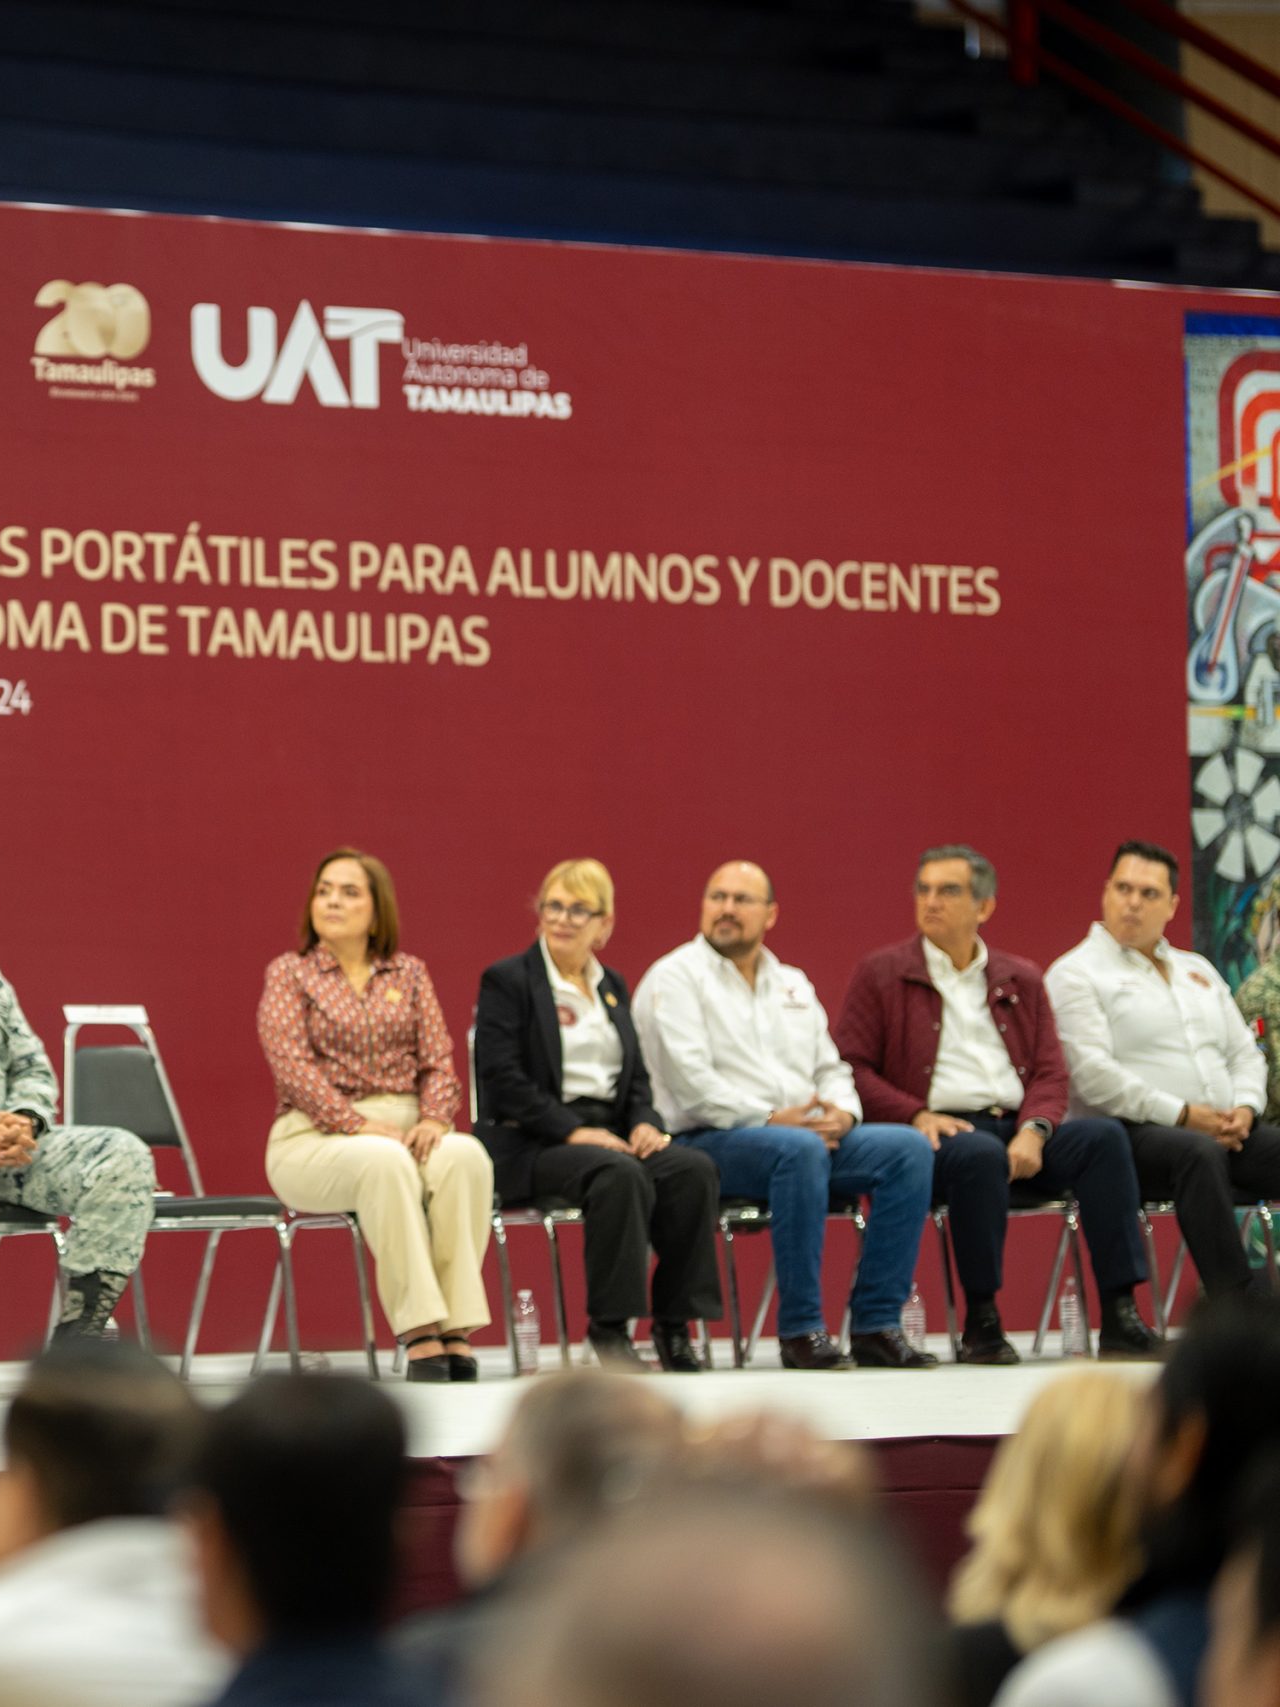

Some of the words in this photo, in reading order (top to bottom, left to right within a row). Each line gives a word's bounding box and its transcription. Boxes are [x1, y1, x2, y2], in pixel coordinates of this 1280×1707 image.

[191, 299, 405, 409] UAT
[401, 337, 528, 368] Universidad
[30, 356, 156, 390] Tamaulipas
[519, 364, 550, 391] de
[402, 383, 573, 420] TAMAULIPAS
[40, 521, 339, 590] PORTÁTILES
[348, 541, 478, 596] PARA
[485, 547, 720, 605] ALUMNOS
[727, 556, 760, 607] Y
[768, 557, 1002, 616] DOCENTES
[100, 602, 169, 656] DE
[177, 605, 491, 667] TAMAULIPAS
